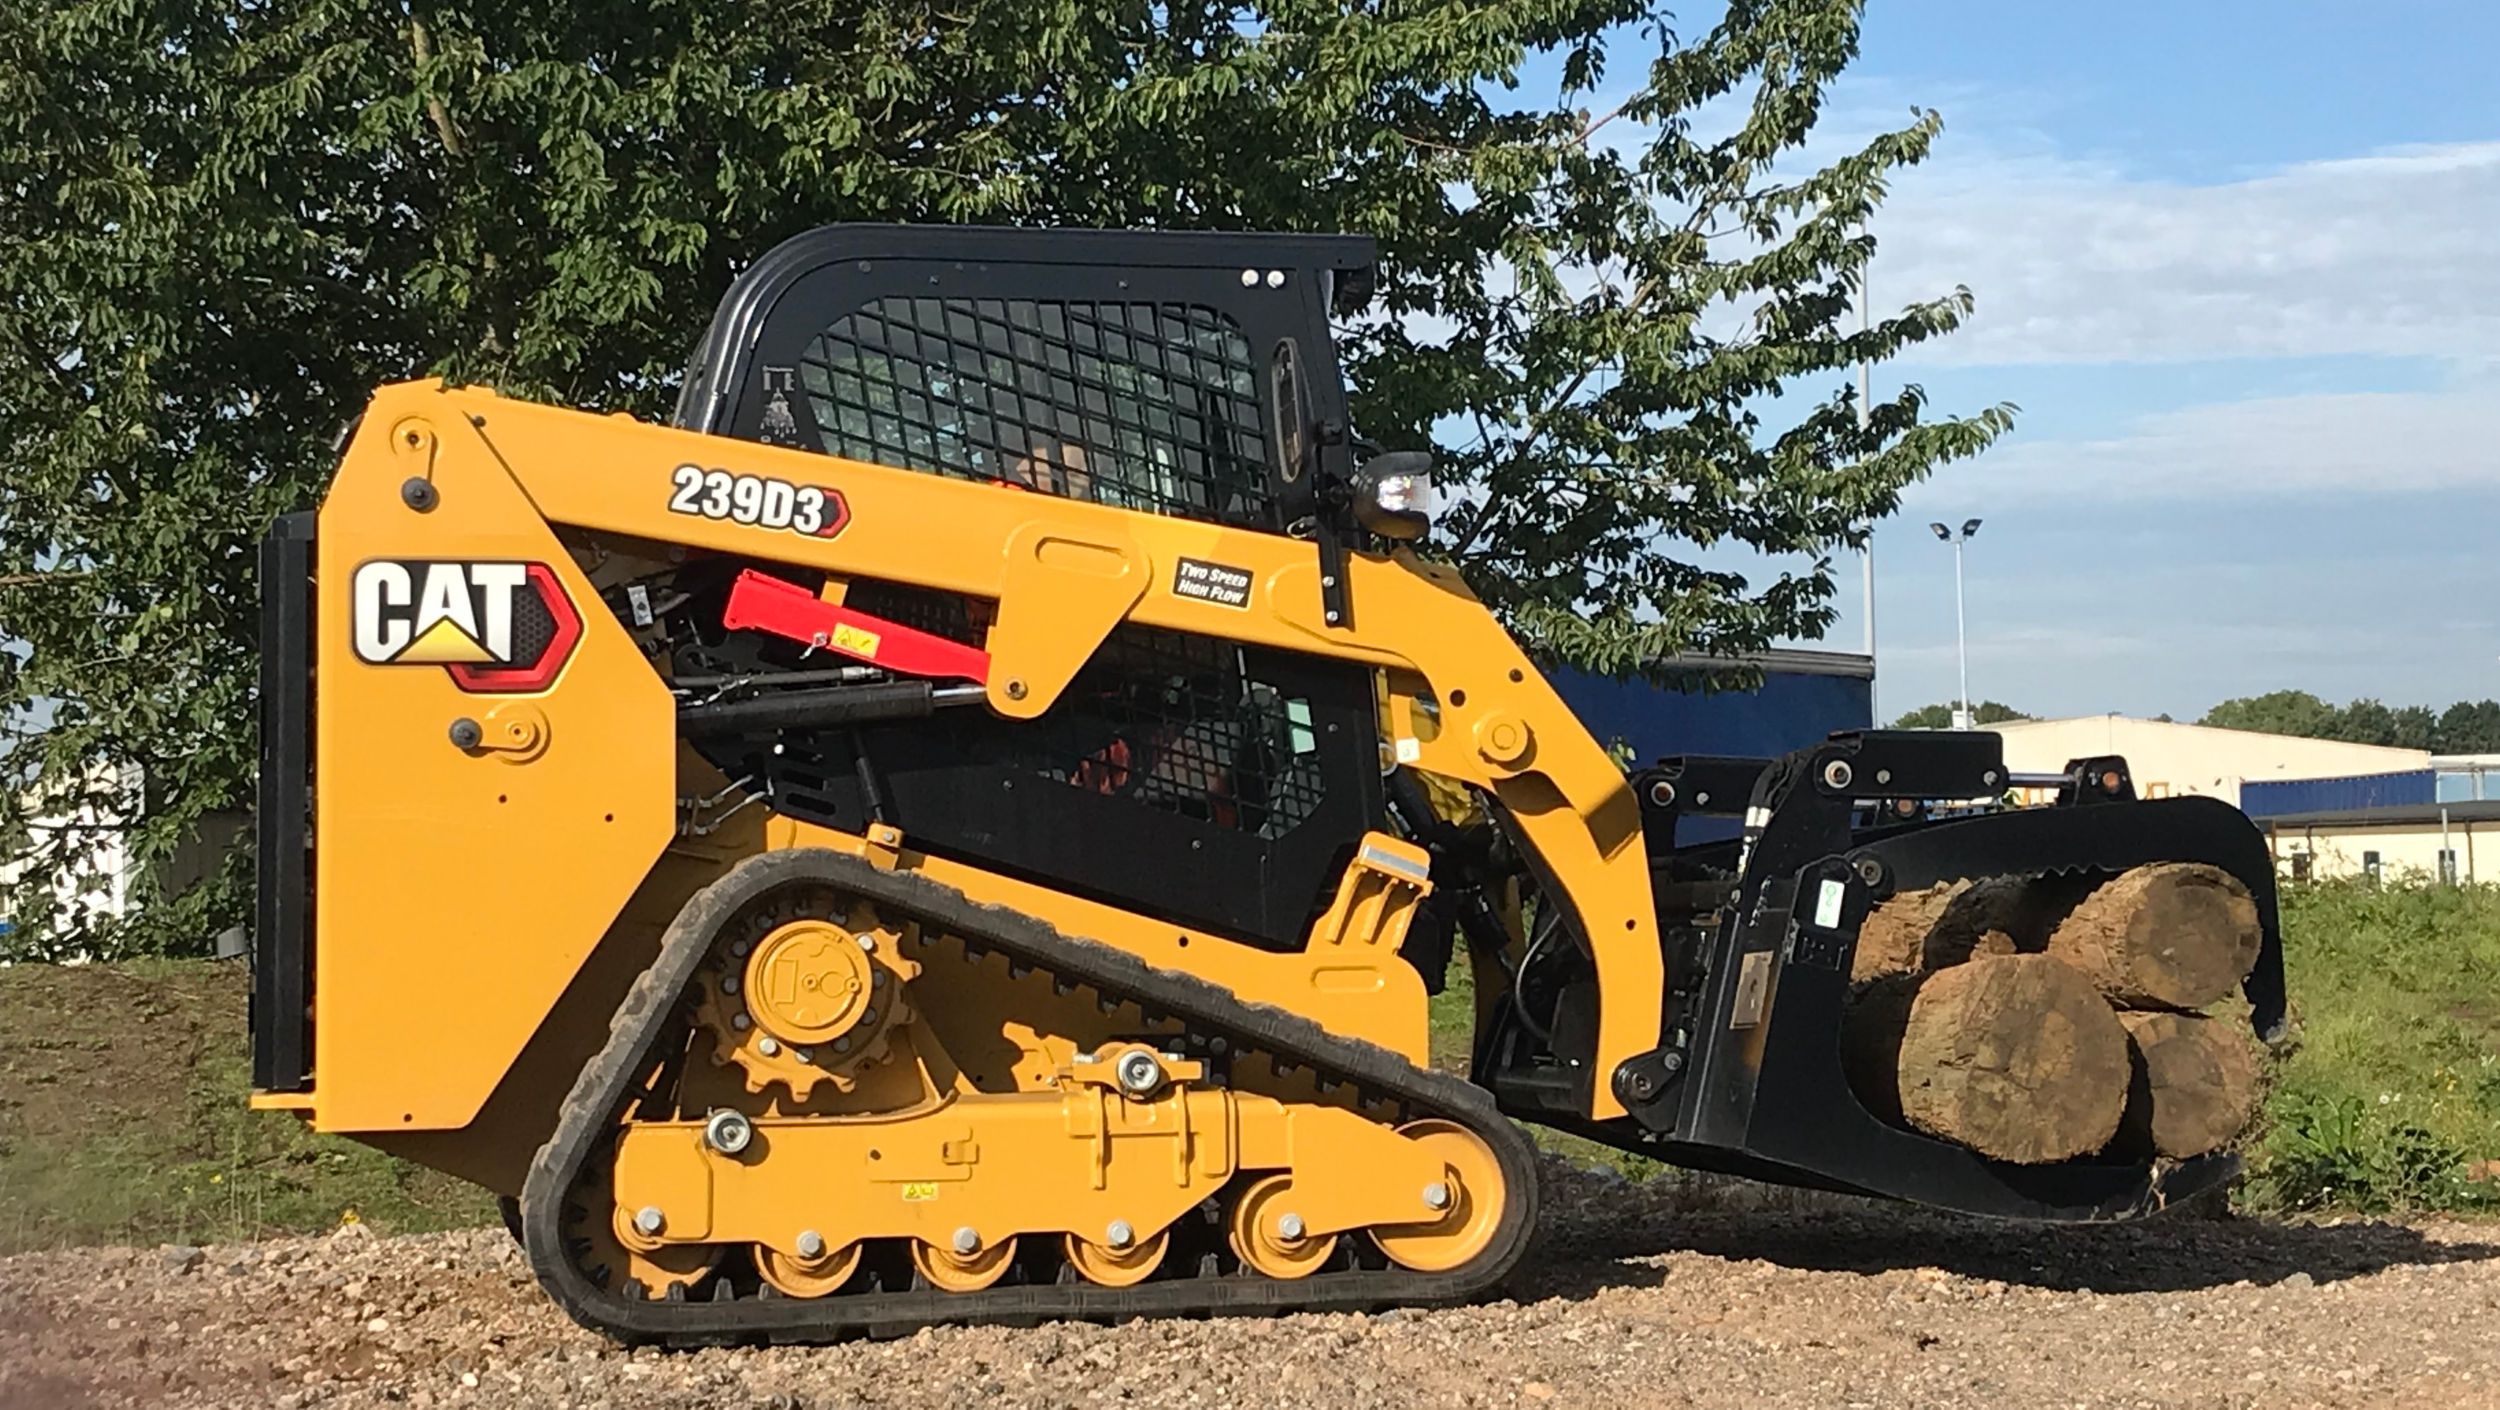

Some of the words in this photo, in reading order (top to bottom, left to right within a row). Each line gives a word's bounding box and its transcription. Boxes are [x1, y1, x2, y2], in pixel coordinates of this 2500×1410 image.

[671, 466, 825, 534] 239D3
[1177, 579, 1209, 597] HIGH
[1210, 586, 1244, 603] FLOW
[1181, 562, 1208, 580] TWO
[1209, 568, 1248, 587] SPEED
[355, 562, 526, 662] CAT
